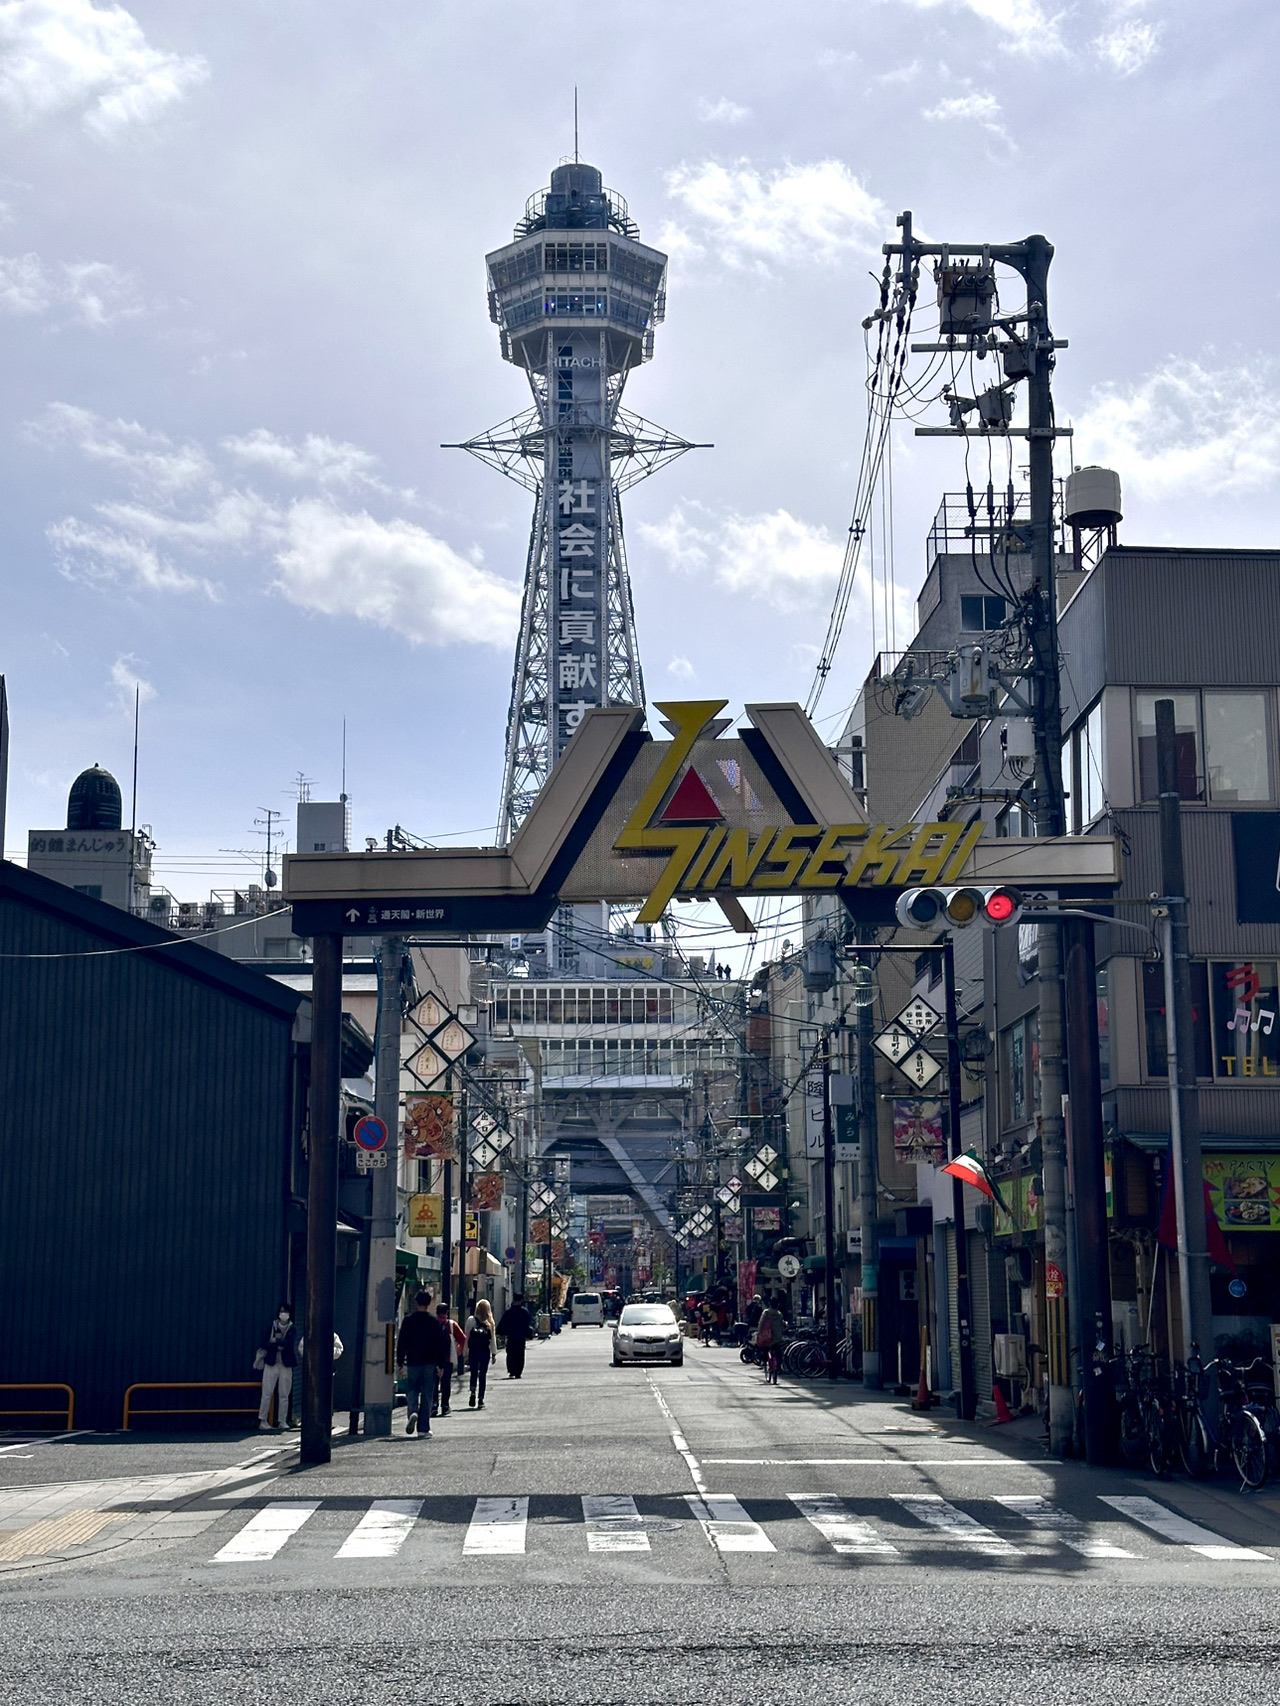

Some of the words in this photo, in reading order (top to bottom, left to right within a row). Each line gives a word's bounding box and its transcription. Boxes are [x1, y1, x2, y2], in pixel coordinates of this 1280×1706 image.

[613, 700, 986, 924] SINSEKAI
[381, 908, 445, 920] 通天閣・新世界
[1225, 962, 1260, 1003] ラ
[915, 1053, 925, 1082] 春日町会
[1221, 1056, 1277, 1076] TEL
[357, 1159, 386, 1167] ここから
[1229, 1160, 1276, 1171] PARTY
